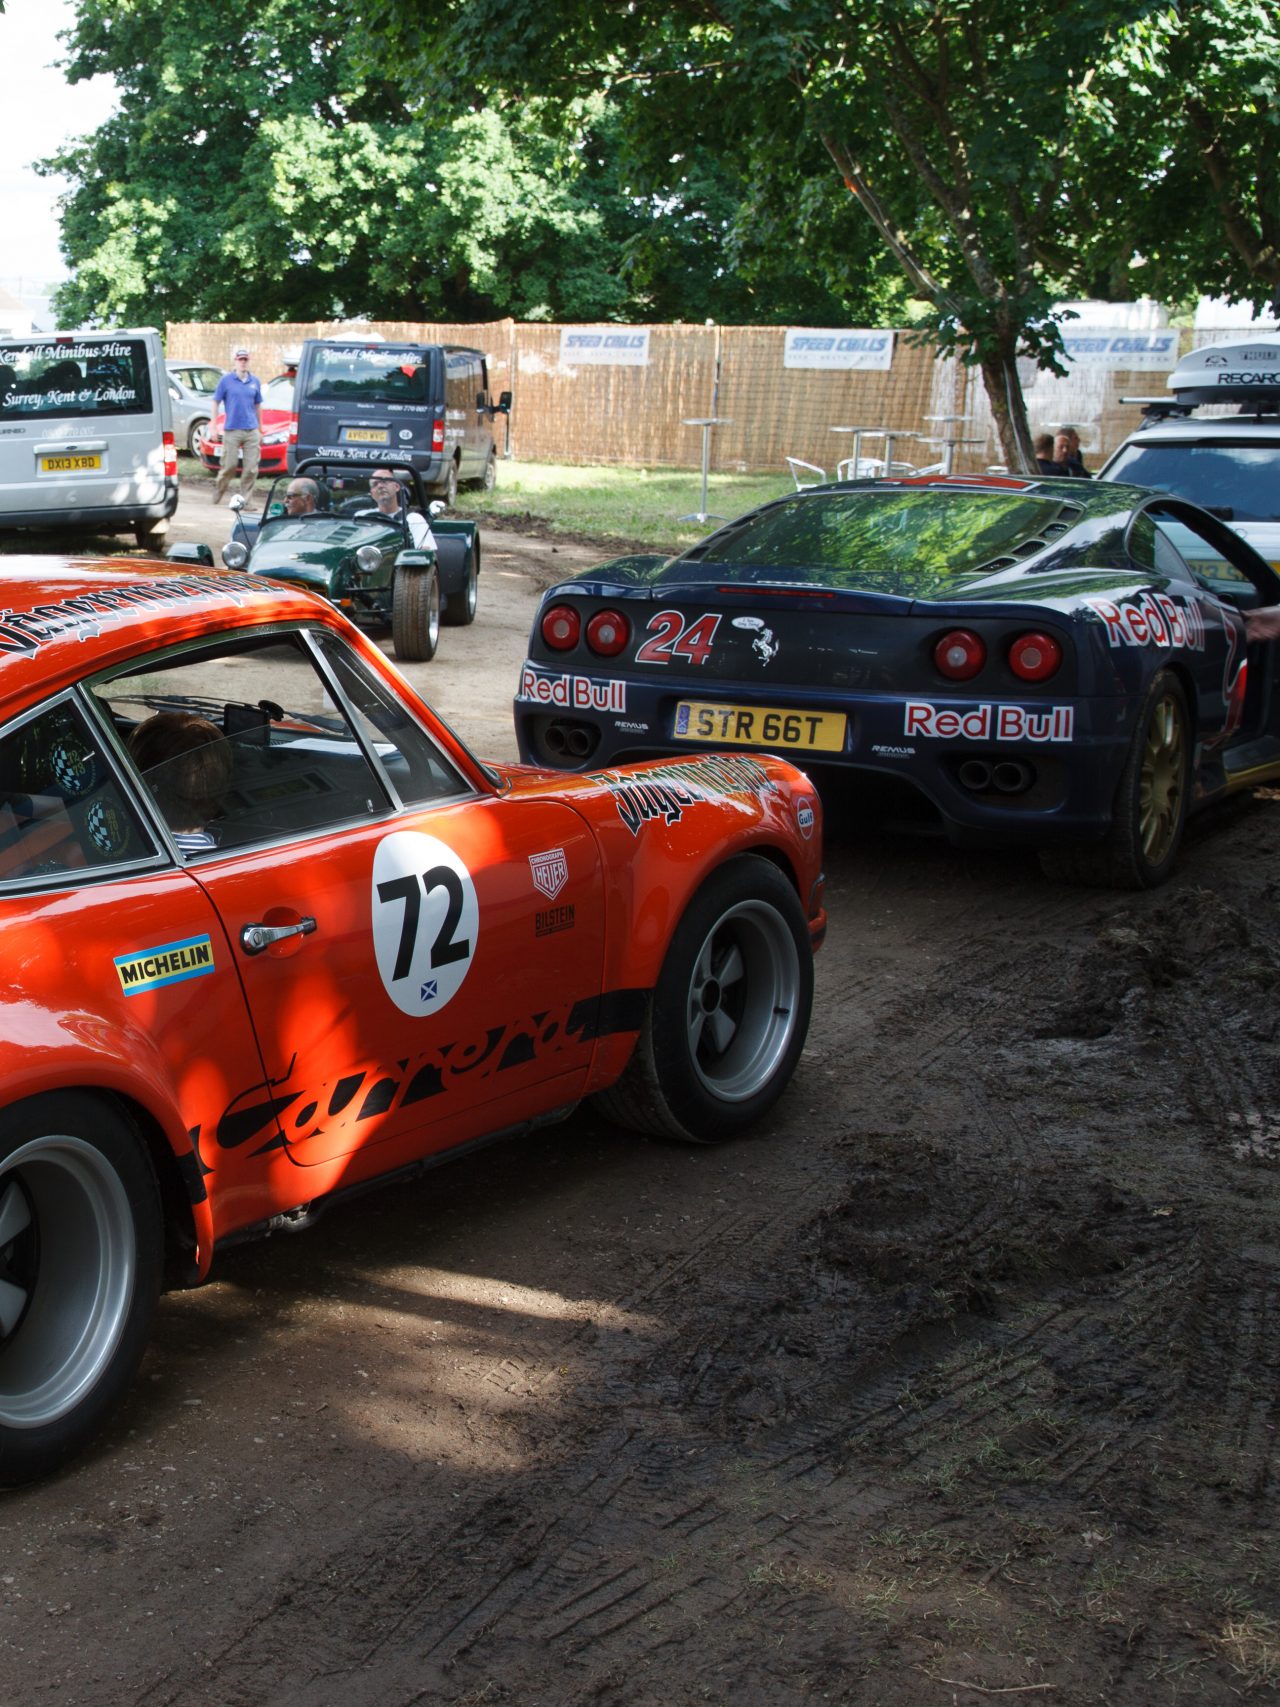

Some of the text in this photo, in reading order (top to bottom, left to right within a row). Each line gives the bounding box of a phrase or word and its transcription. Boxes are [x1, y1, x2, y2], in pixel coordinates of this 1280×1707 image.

[45, 344, 99, 359] Minibus
[101, 342, 132, 357] Hire
[790, 337, 888, 352] SPEED CHILLS
[2, 386, 136, 409] Surrey, Kent & London
[48, 456, 95, 470] DX13 XBD
[635, 610, 722, 665] 24
[1082, 593, 1205, 652] Red Bull
[522, 670, 626, 713] Red Bull
[697, 710, 823, 745] STR 66T
[904, 702, 1074, 742] Red Bull
[798, 811, 815, 827] Gulf
[531, 851, 563, 865] CHRONOGRAPH
[535, 861, 566, 893] HEUER
[376, 865, 470, 982] 72
[535, 904, 575, 930] BILSTEIN
[120, 945, 210, 984] MICHELIN
